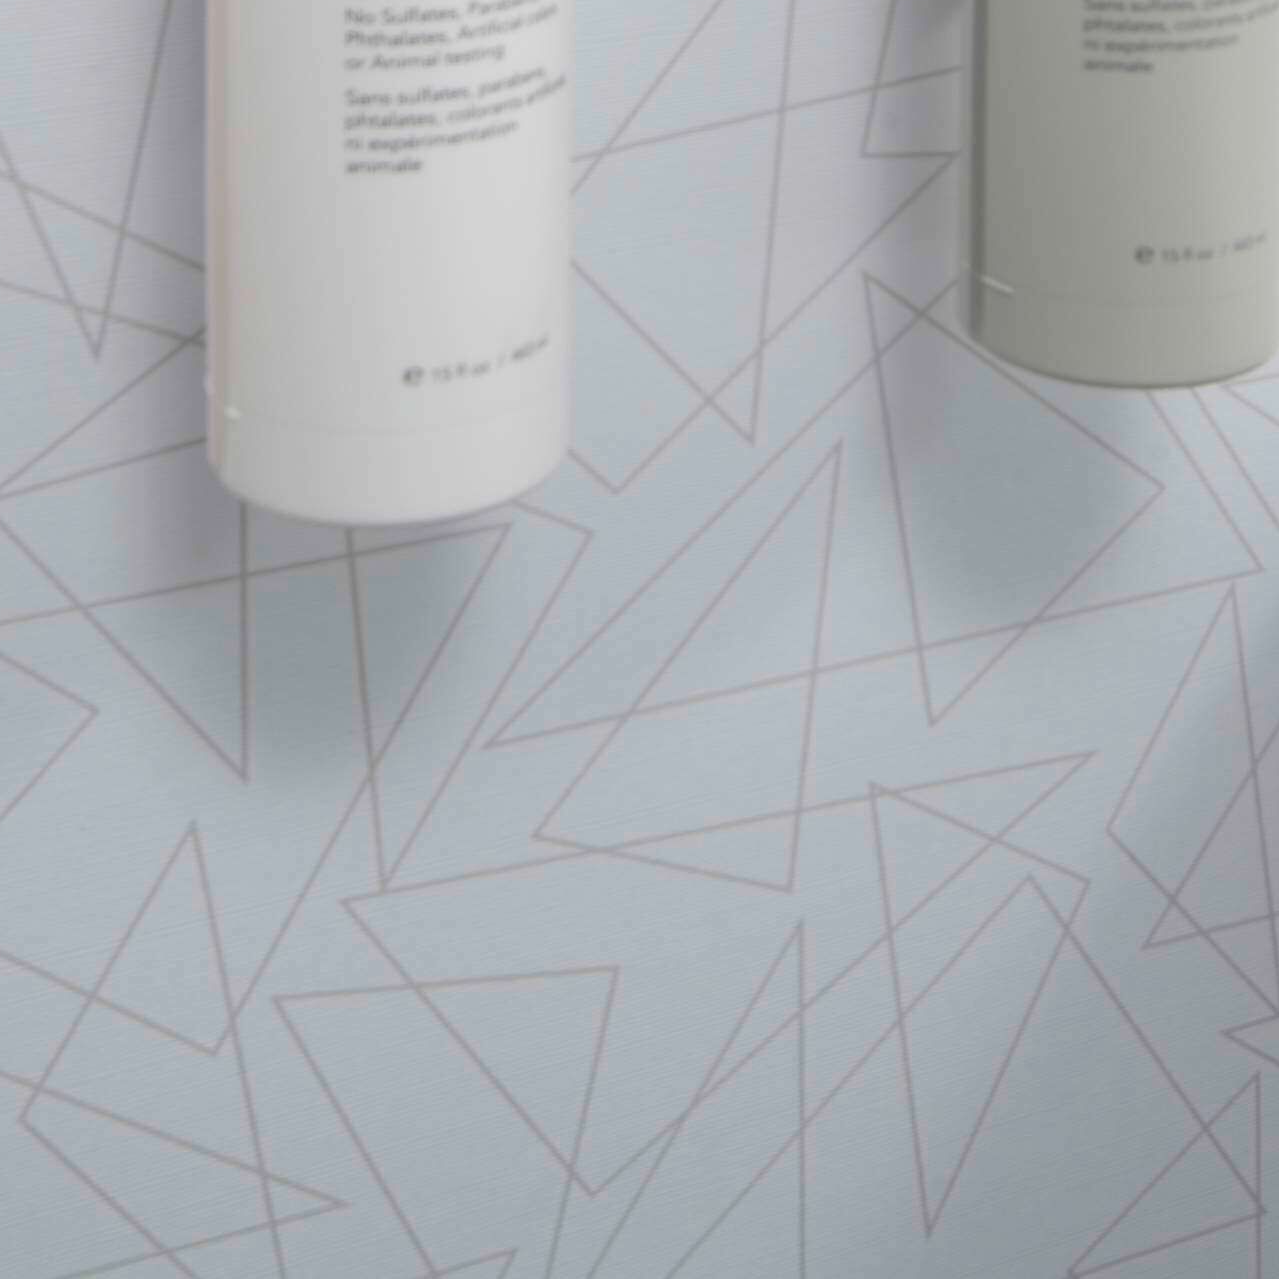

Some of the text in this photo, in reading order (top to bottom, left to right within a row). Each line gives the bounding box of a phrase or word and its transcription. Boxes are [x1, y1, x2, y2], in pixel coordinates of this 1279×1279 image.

[344, 8, 376, 24] No
[344, 44, 506, 70] or Animal testing
[344, 88, 392, 106] Sans
